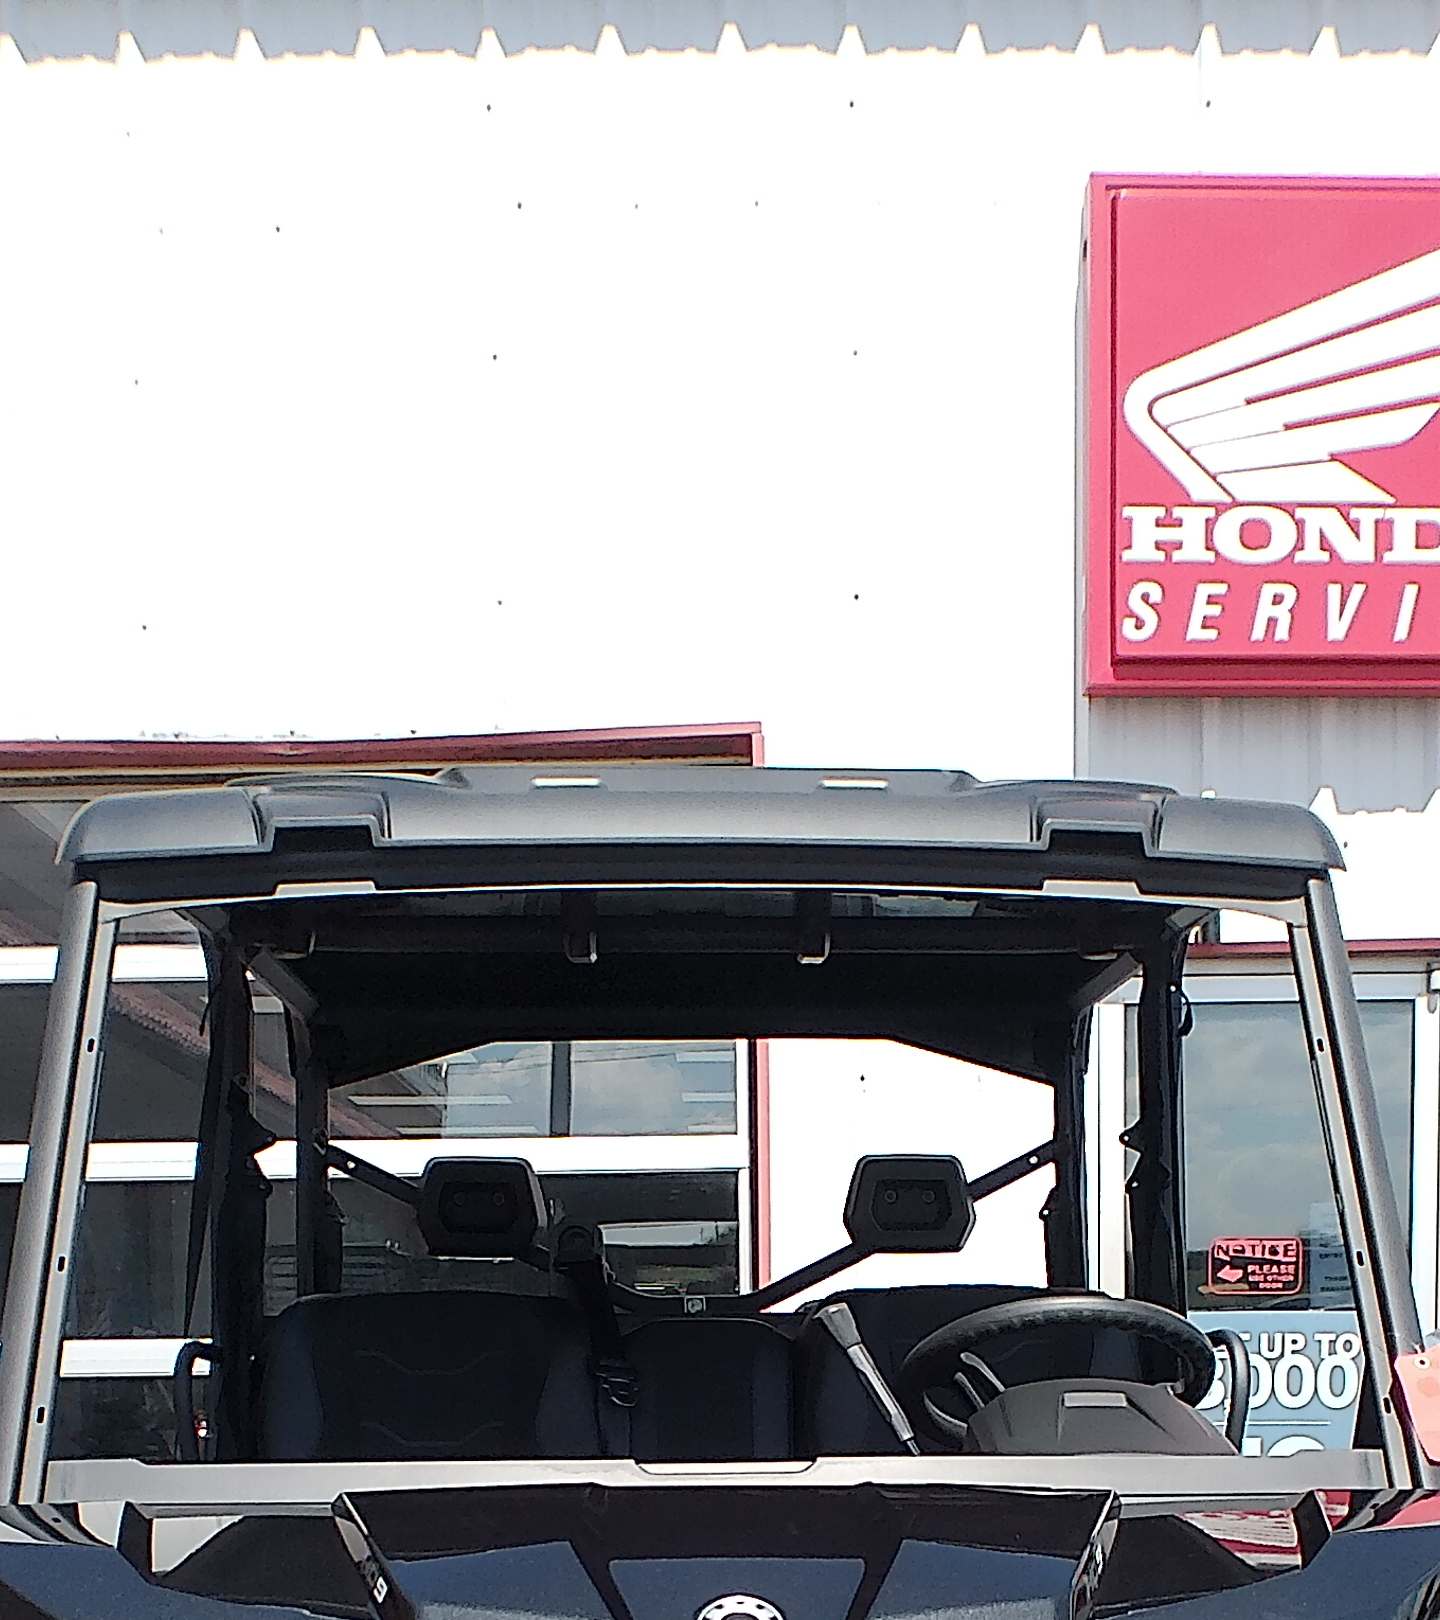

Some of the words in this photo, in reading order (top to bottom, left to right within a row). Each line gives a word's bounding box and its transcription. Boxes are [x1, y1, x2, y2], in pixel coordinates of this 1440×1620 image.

[1216, 1243, 1296, 1259] NOTICE
[1247, 1264, 1296, 1275] PLEASE
[1259, 1332, 1307, 1360] UP
[1313, 1332, 1361, 1360] TO
